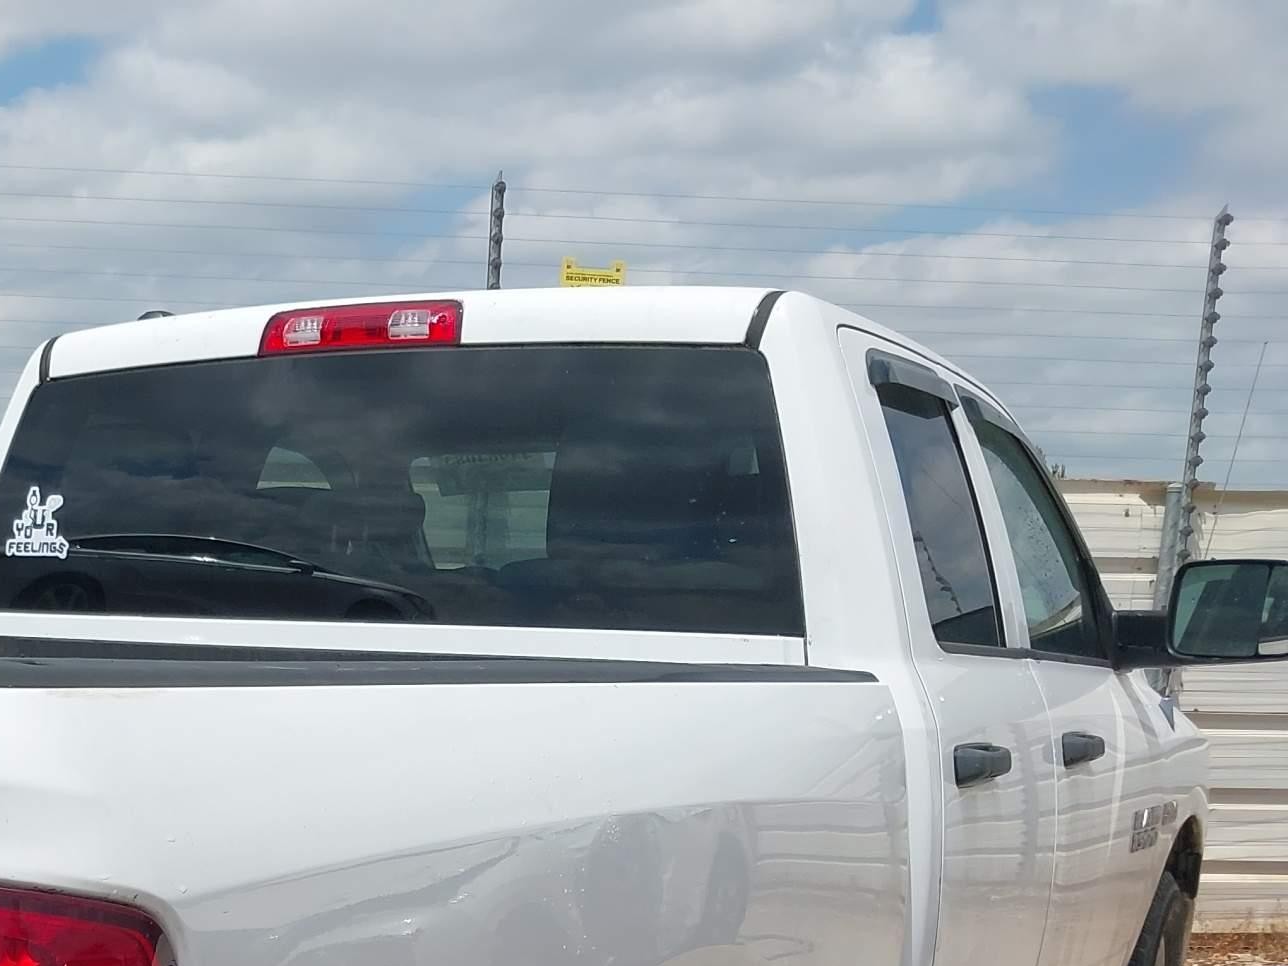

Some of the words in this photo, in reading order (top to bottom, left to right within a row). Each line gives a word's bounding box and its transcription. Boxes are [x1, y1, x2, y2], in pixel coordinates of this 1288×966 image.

[565, 275, 598, 284] SECURITY
[15, 509, 55, 539] YOUR
[8, 541, 67, 554] FEELINGS
